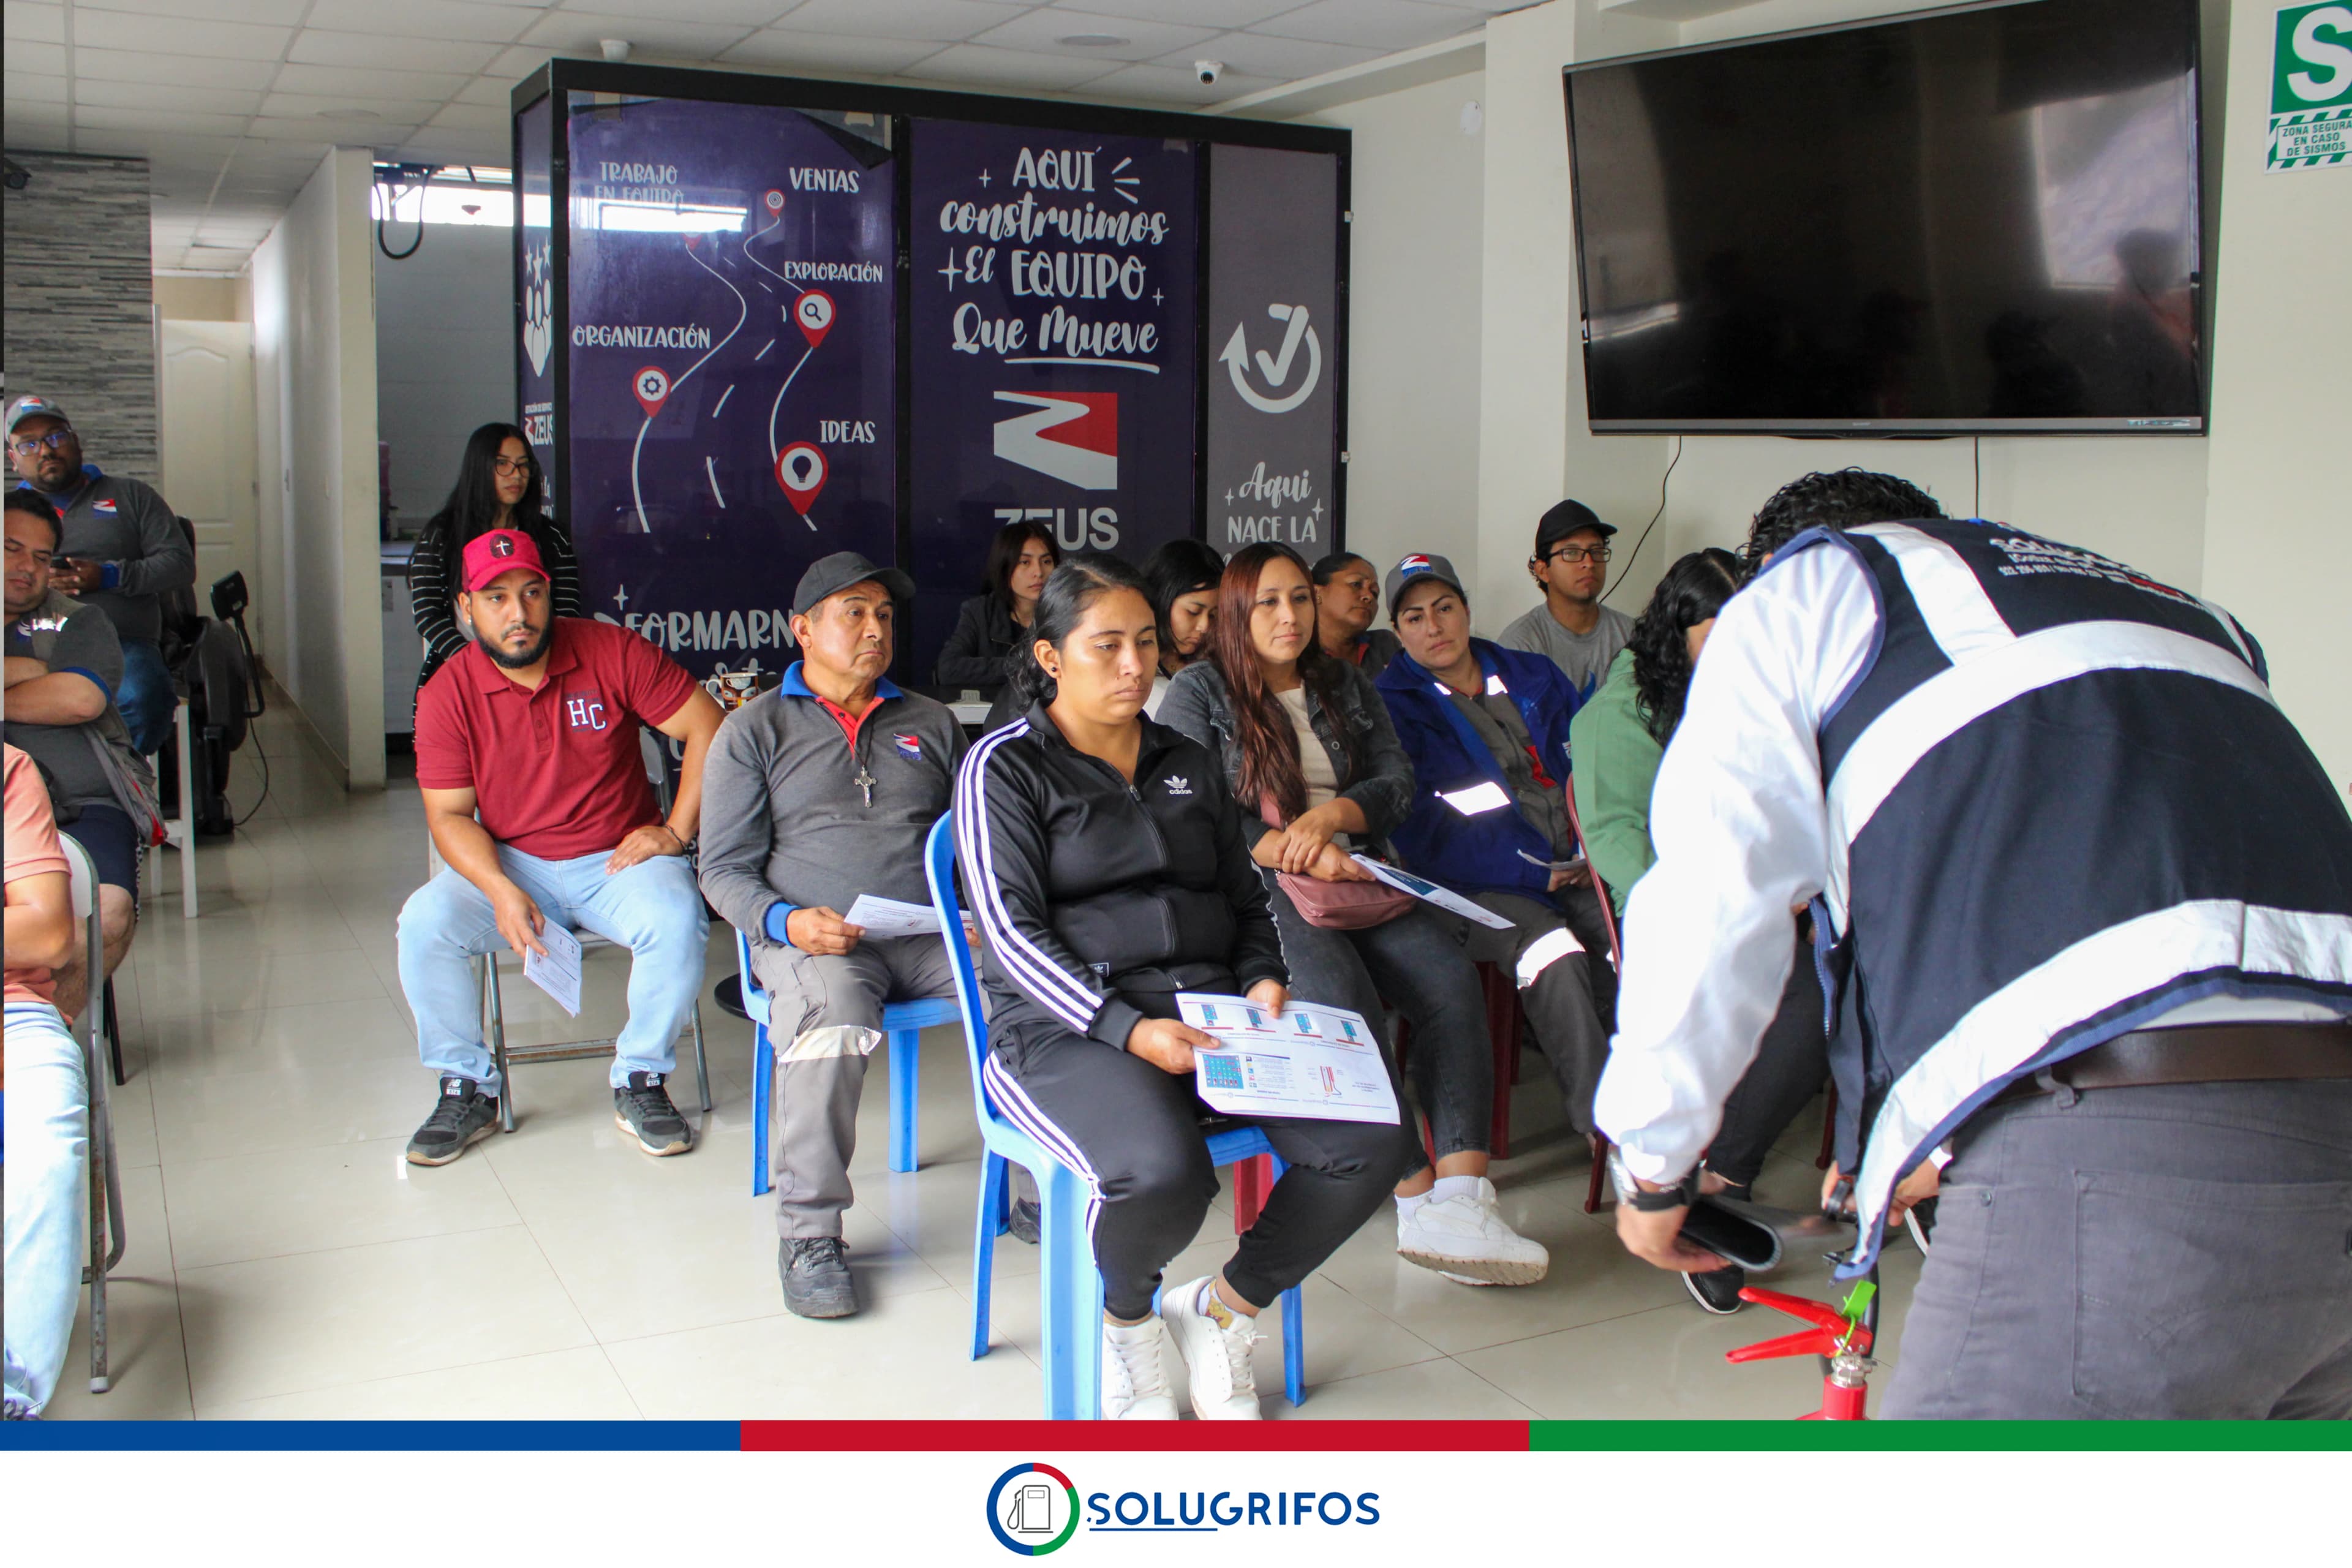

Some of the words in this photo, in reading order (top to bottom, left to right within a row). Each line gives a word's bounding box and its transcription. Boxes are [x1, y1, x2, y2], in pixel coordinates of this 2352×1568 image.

[2287, 6, 2352, 102] S
[2283, 125, 2309, 137] ZONA
[2312, 119, 2352, 134] SEGURA
[2294, 135, 2307, 146] EN
[2311, 131, 2340, 143] CASO
[2286, 146, 2301, 157] DE
[2304, 141, 2346, 155] SISMOS
[600, 161, 678, 184] TRABAJO
[790, 167, 860, 193] VENTAS
[1012, 146, 1101, 192] AQUÍ
[940, 191, 1169, 246] construimos
[784, 260, 883, 283] EXPLORACIÓN
[965, 246, 996, 283] El
[1011, 249, 1147, 300] EQUIPO
[572, 322, 710, 349] ORGANIZACIÓN
[952, 303, 1027, 354] Que
[1039, 306, 1159, 357] Mueve
[820, 420, 876, 443] IDEAS
[1239, 461, 1312, 509] Aqui
[1227, 516, 1282, 543] NACE
[1291, 516, 1317, 543] LA
[567, 698, 607, 730] HC
